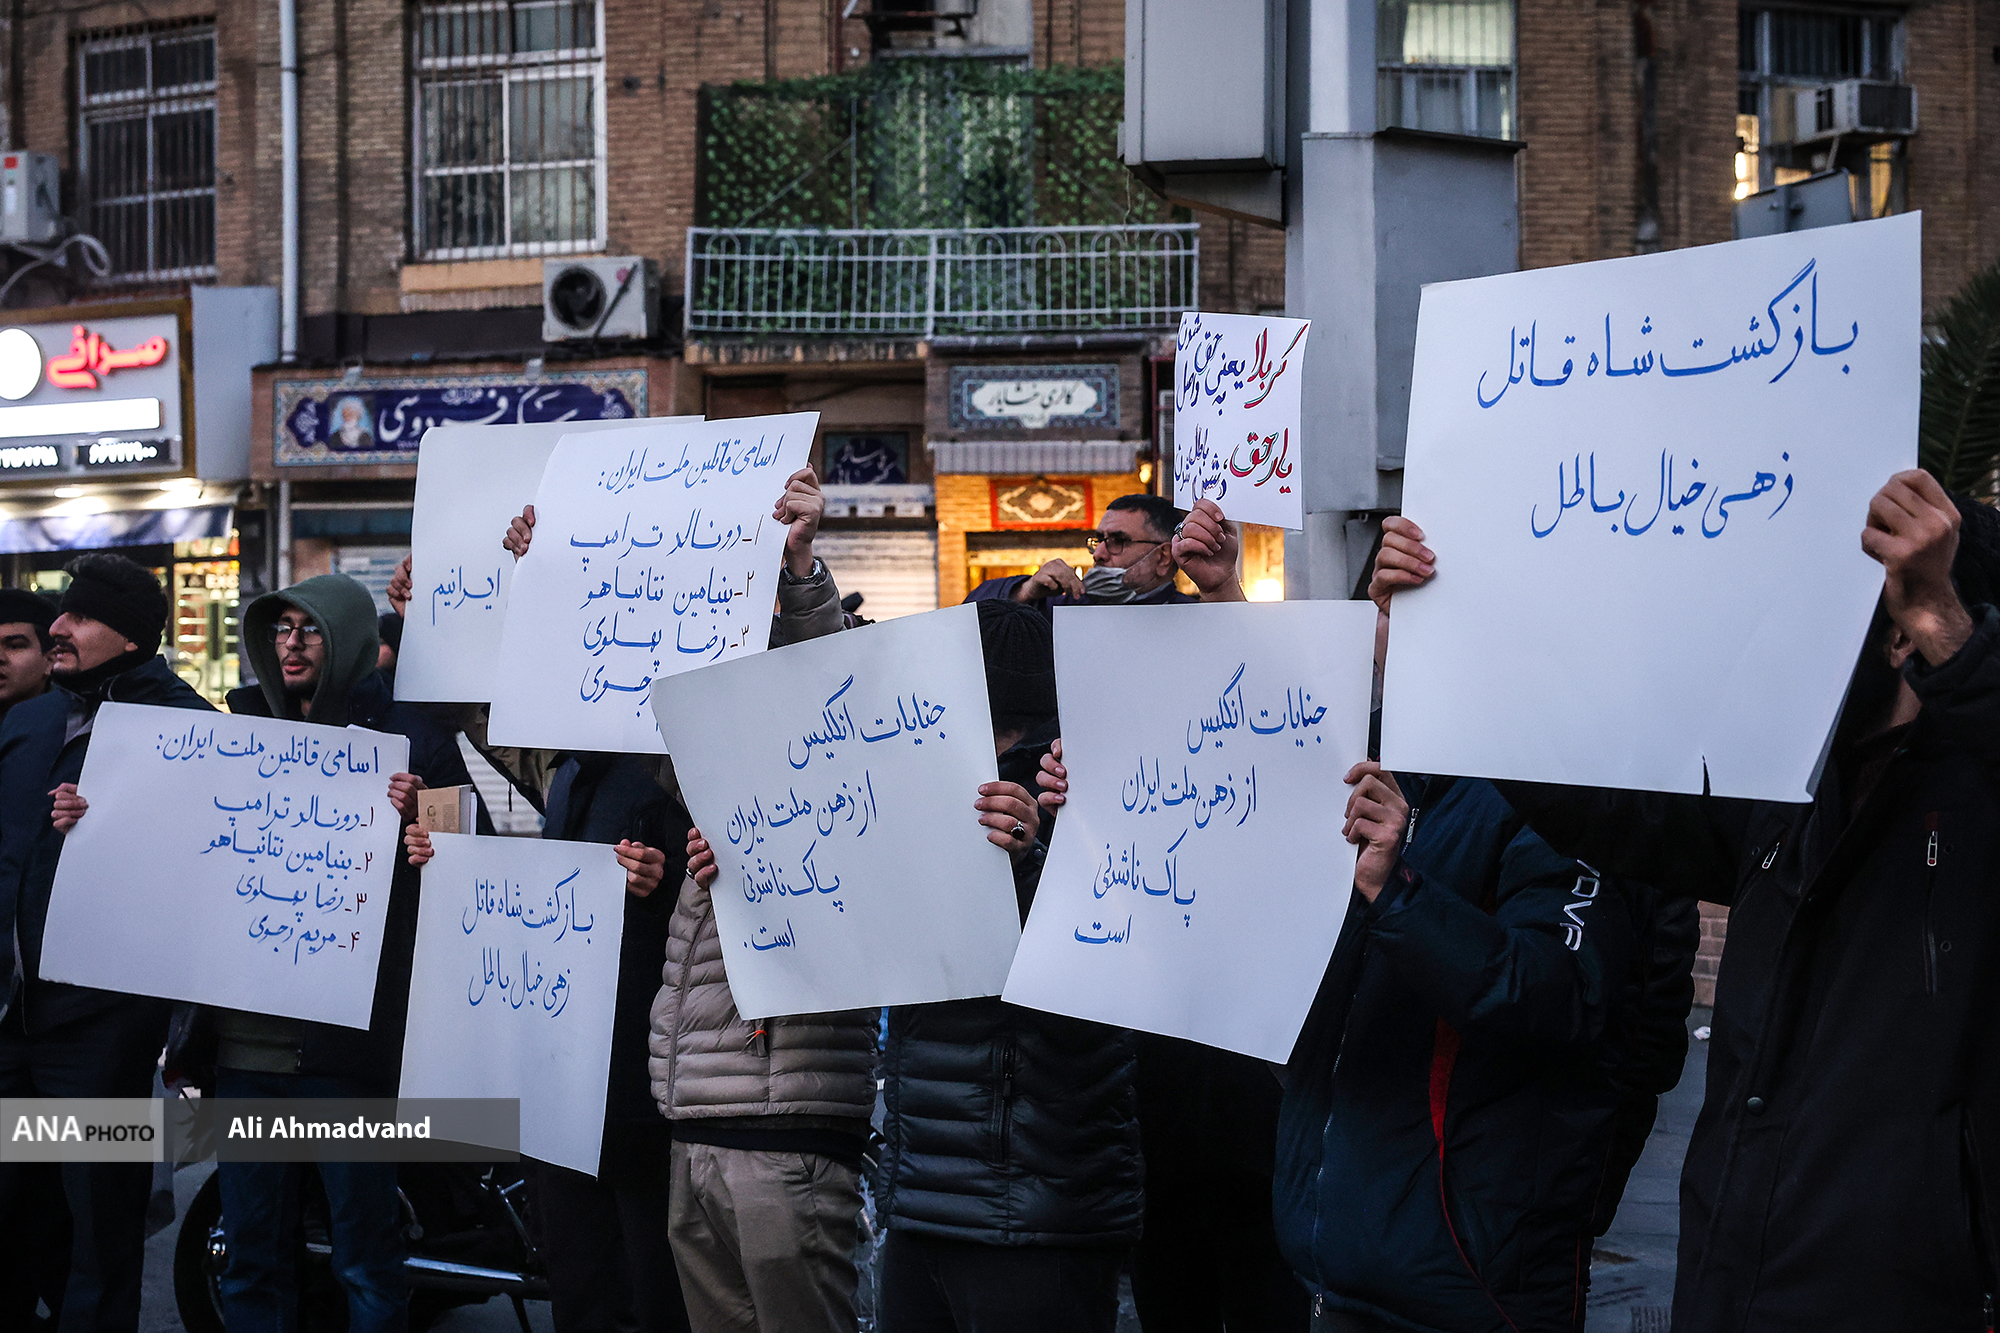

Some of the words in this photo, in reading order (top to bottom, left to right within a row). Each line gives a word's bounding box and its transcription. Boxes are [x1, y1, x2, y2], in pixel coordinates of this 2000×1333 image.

[46, 325, 167, 389] صرافی
[1194, 331, 1224, 375] حق
[1243, 323, 1309, 409] کربلا
[1477, 318, 1575, 409] قاتل
[1586, 312, 1655, 377] شاه
[1205, 352, 1245, 396] یعنی
[1211, 390, 1227, 416] به
[643, 442, 690, 482] ملت
[684, 438, 741, 489] قاتلین
[732, 433, 785, 476] اسامی
[1253, 427, 1293, 494] یار
[1531, 451, 1625, 539] باطل
[1624, 447, 1707, 536] خیال
[570, 511, 663, 573] ترامپ
[665, 507, 742, 557] دونالد
[432, 566, 500, 626] ایرانیم
[579, 565, 664, 612] نتانیاهو
[673, 566, 733, 616] بنیامین
[583, 610, 662, 674] پهلوی
[675, 619, 728, 662] رضا
[788, 674, 855, 770] انگلیس
[860, 692, 946, 746] جنایات
[1187, 662, 1246, 754] انگلیس
[1250, 686, 1328, 747] جنایات
[216, 731, 265, 757] ملت
[258, 734, 319, 778] قاتلین
[321, 742, 379, 777] اسامی
[767, 787, 812, 827] ملت
[816, 781, 855, 836] ذهن
[856, 769, 877, 838] از
[1122, 755, 1160, 815] ایران
[1162, 765, 1198, 806] ملت
[1194, 773, 1236, 829] ذهن
[1236, 764, 1257, 827] از
[214, 791, 290, 831] ترامپ
[290, 795, 361, 831] دونالد
[726, 795, 765, 855] ایران
[200, 828, 284, 863] نتانیاهو
[285, 841, 352, 880] بنیامین
[1093, 841, 1140, 900] ناشدنی
[236, 874, 308, 922] پهلوی
[315, 882, 344, 914] رضا
[498, 879, 523, 917] شاه
[741, 857, 787, 904] ناشدنی
[787, 839, 844, 913] پاک
[1142, 828, 1196, 928] پاک
[462, 878, 495, 935] قاتل
[1073, 914, 1132, 945] است
[248, 914, 294, 953] رجوی
[293, 927, 337, 965] مریم
[468, 947, 510, 1006] باطل
[510, 949, 544, 1010] خیال
[543, 968, 571, 1018] زهی
